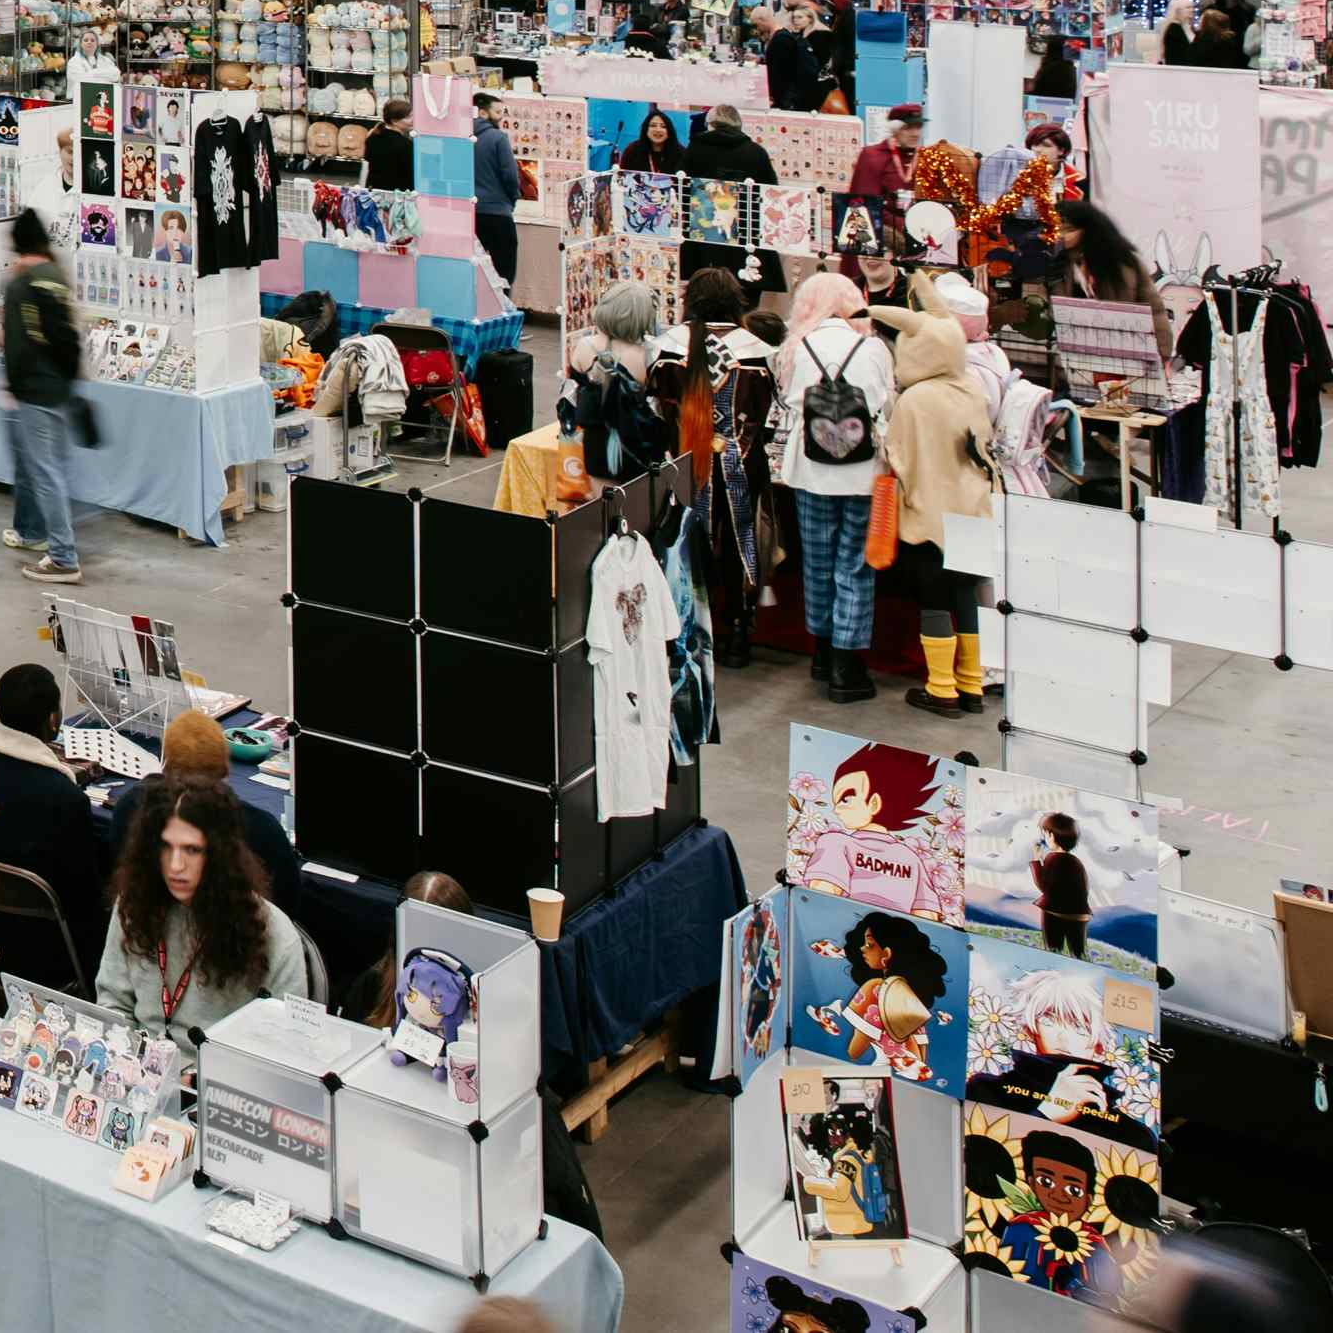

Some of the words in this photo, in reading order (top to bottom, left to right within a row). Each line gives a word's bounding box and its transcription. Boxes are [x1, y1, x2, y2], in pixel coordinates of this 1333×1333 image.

[159, 91, 185, 99] SEVEN
[1144, 100, 1219, 130] YIRU
[1149, 130, 1220, 153] SANN
[855, 851, 912, 880] BADMAN
[1110, 993, 1139, 1011] £15
[204, 1085, 272, 1124] ANIMECON
[274, 1110, 327, 1145] LONDON
[1032, 1091, 1052, 1103] are
[1076, 1104, 1121, 1123] special
[206, 1107, 271, 1139] アニメコン
[278, 1136, 327, 1162] ロンドン
[206, 1132, 264, 1164] NEKOARCADE
